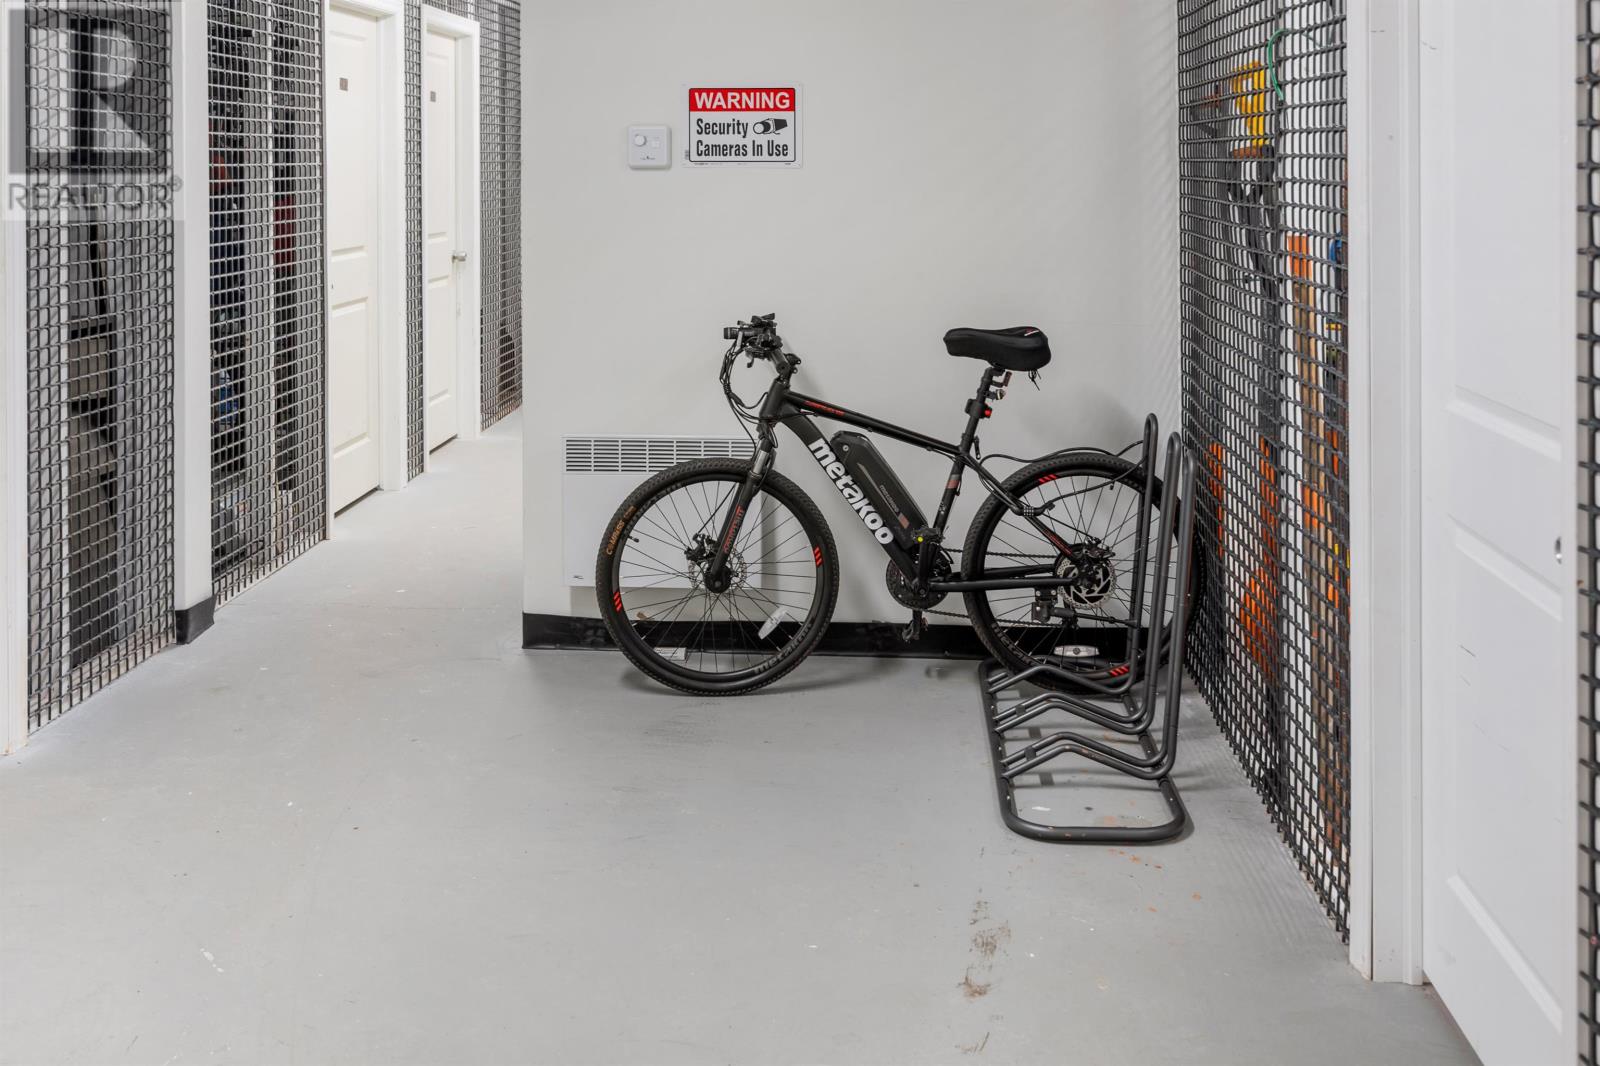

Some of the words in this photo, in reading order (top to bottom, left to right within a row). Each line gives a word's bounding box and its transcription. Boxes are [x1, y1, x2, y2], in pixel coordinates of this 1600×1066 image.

[695, 91, 790, 109] WARNING
[696, 118, 749, 138] Security
[696, 139, 748, 157] Cameras
[752, 139, 763, 157] In
[767, 139, 789, 157] Use
[809, 437, 894, 545] metakoo
